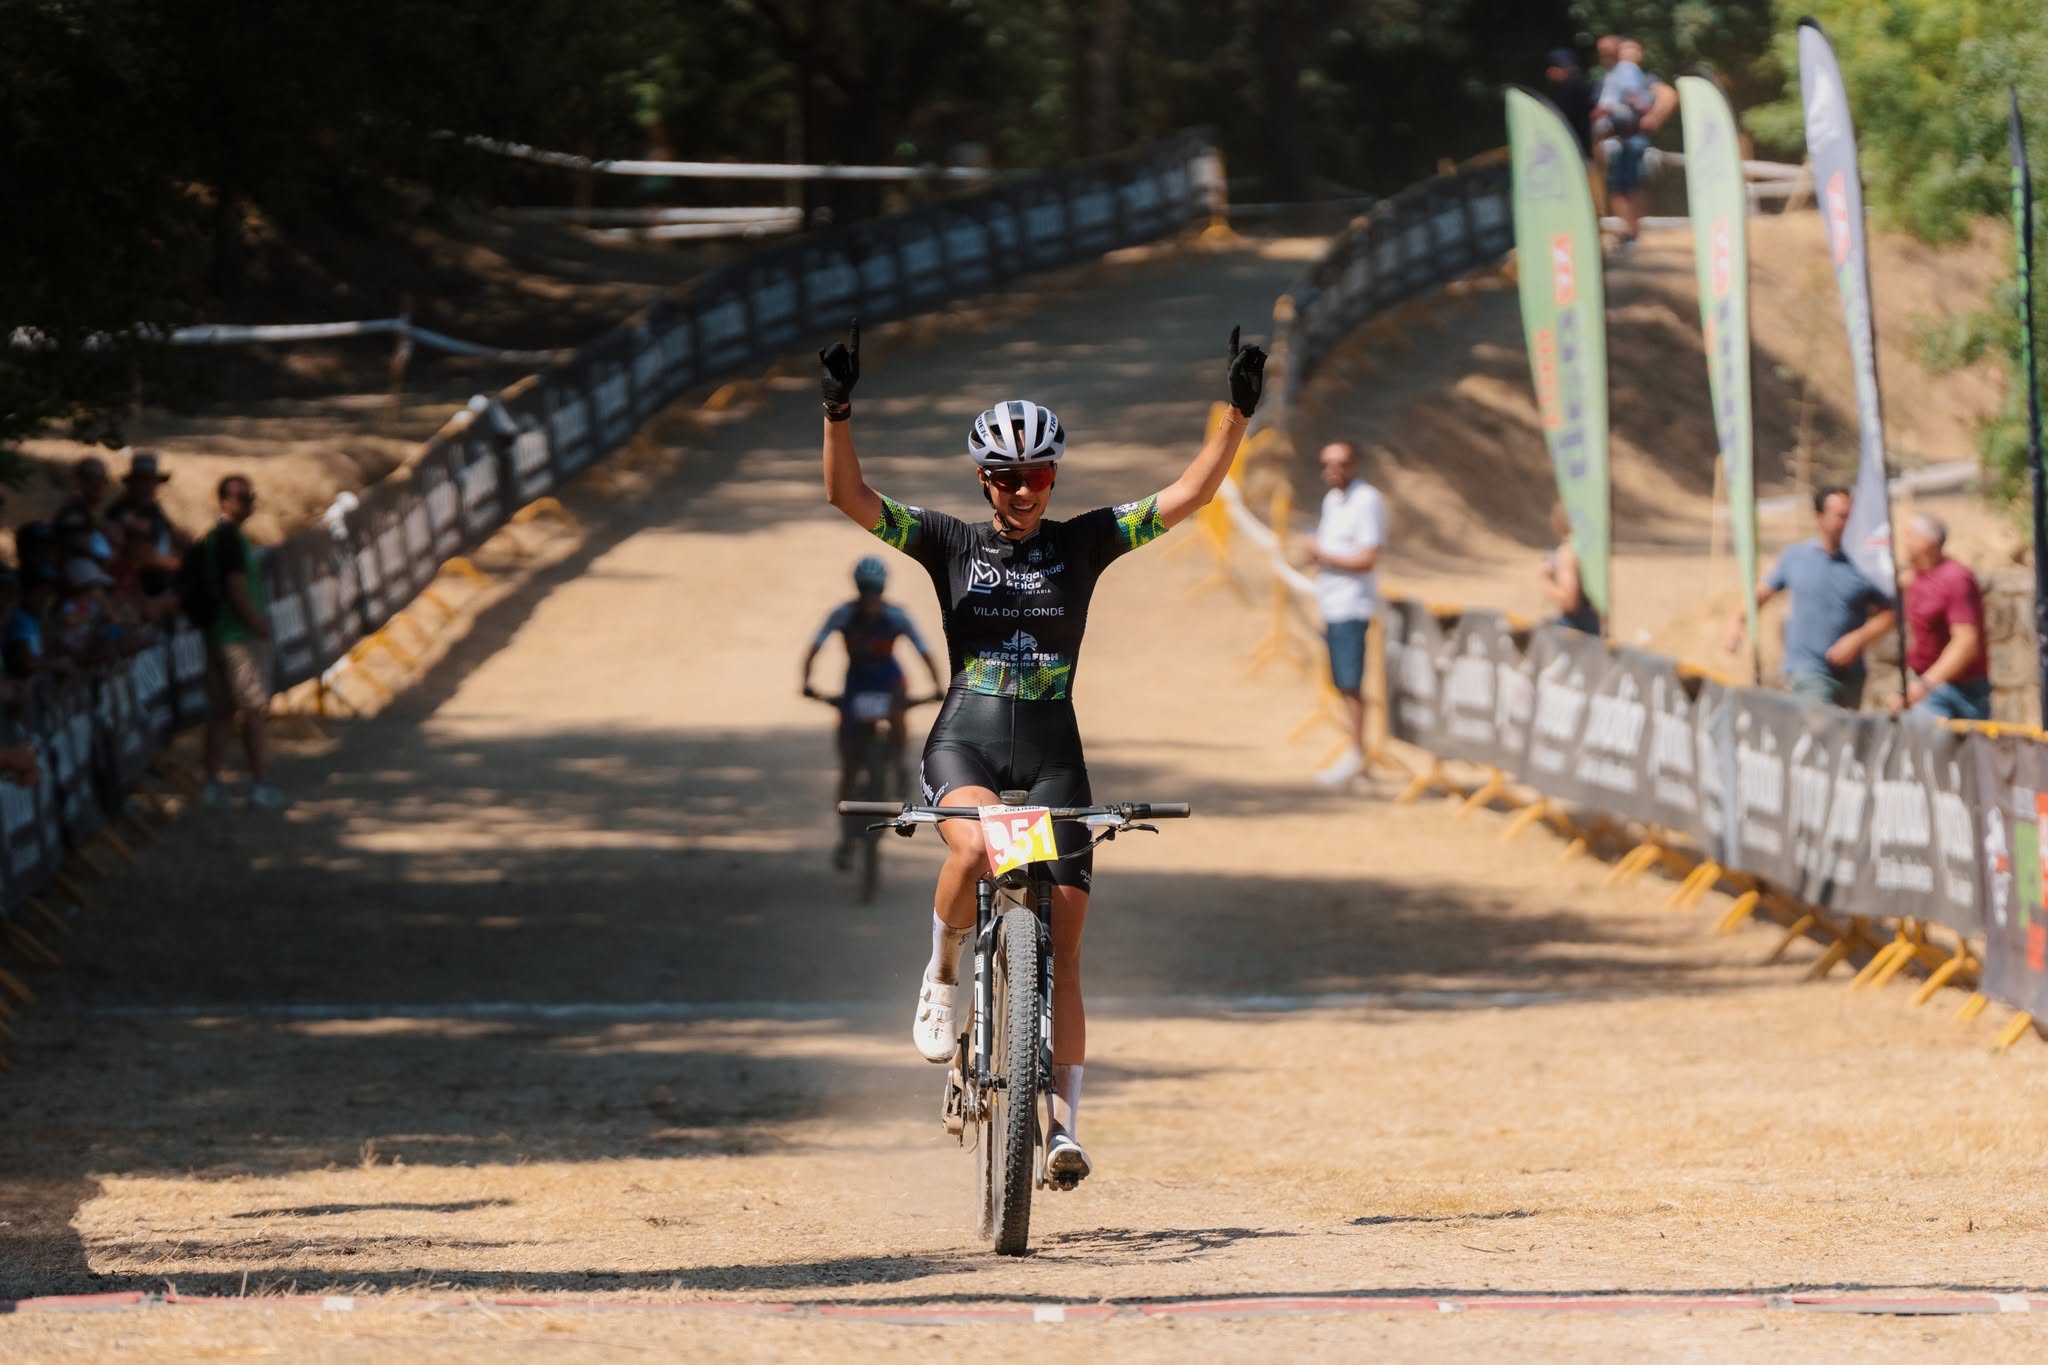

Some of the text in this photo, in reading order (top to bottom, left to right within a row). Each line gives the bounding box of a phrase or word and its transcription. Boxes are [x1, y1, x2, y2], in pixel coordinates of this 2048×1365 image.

[973, 607, 1065, 617] VILA DO CONDE
[986, 816, 1053, 866] 951
